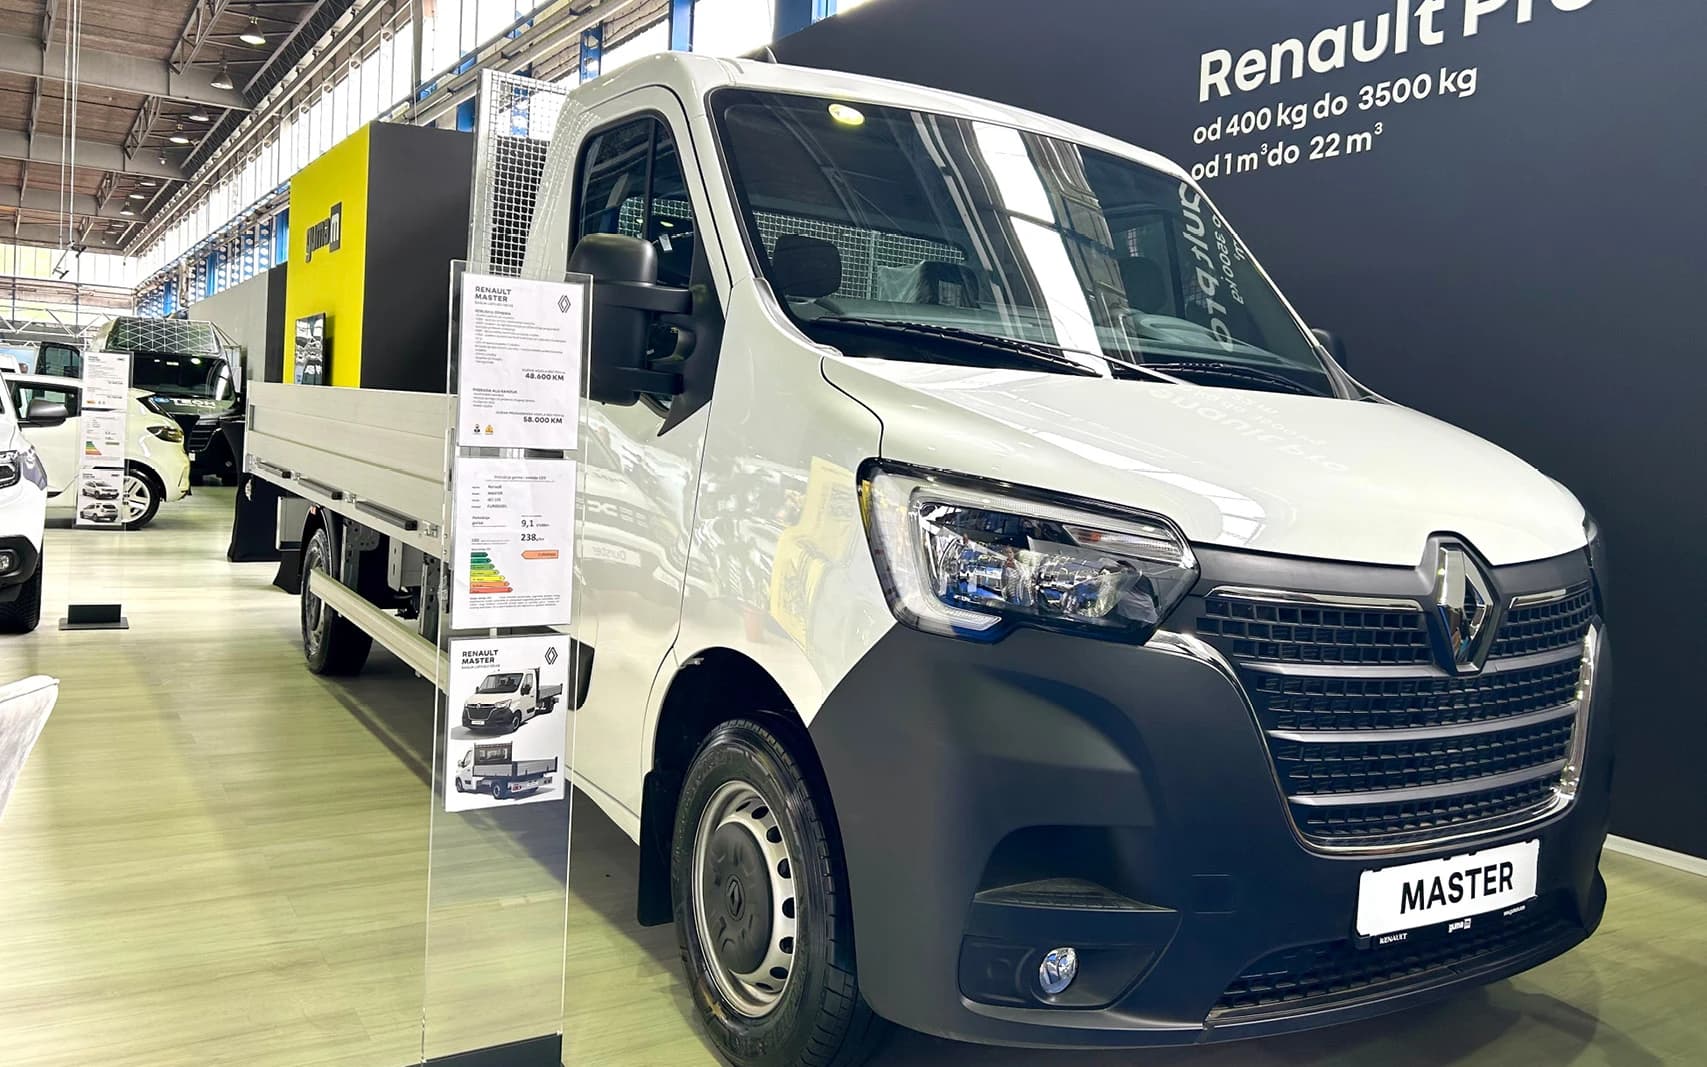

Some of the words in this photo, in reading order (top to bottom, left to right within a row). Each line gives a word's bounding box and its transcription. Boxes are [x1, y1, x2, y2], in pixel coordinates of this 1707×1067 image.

[1200, 0, 1445, 102] Renault
[1193, 117, 1222, 144] od
[1225, 107, 1271, 137] 400
[1276, 102, 1308, 130] kg
[1312, 93, 1348, 120] do
[1357, 73, 1432, 110] 3500
[1439, 67, 1477, 97] kg
[1191, 153, 1219, 181] od
[1224, 153, 1233, 175] 1
[1267, 142, 1300, 168] do
[1309, 133, 1341, 160] 22
[475, 286, 512, 296] RENAULT
[474, 293, 508, 302] MASTER
[552, 374, 565, 382] KM
[462, 649, 499, 658] RENAULT
[1400, 861, 1513, 914] MASTER
[1379, 932, 1407, 944] RENAULT
